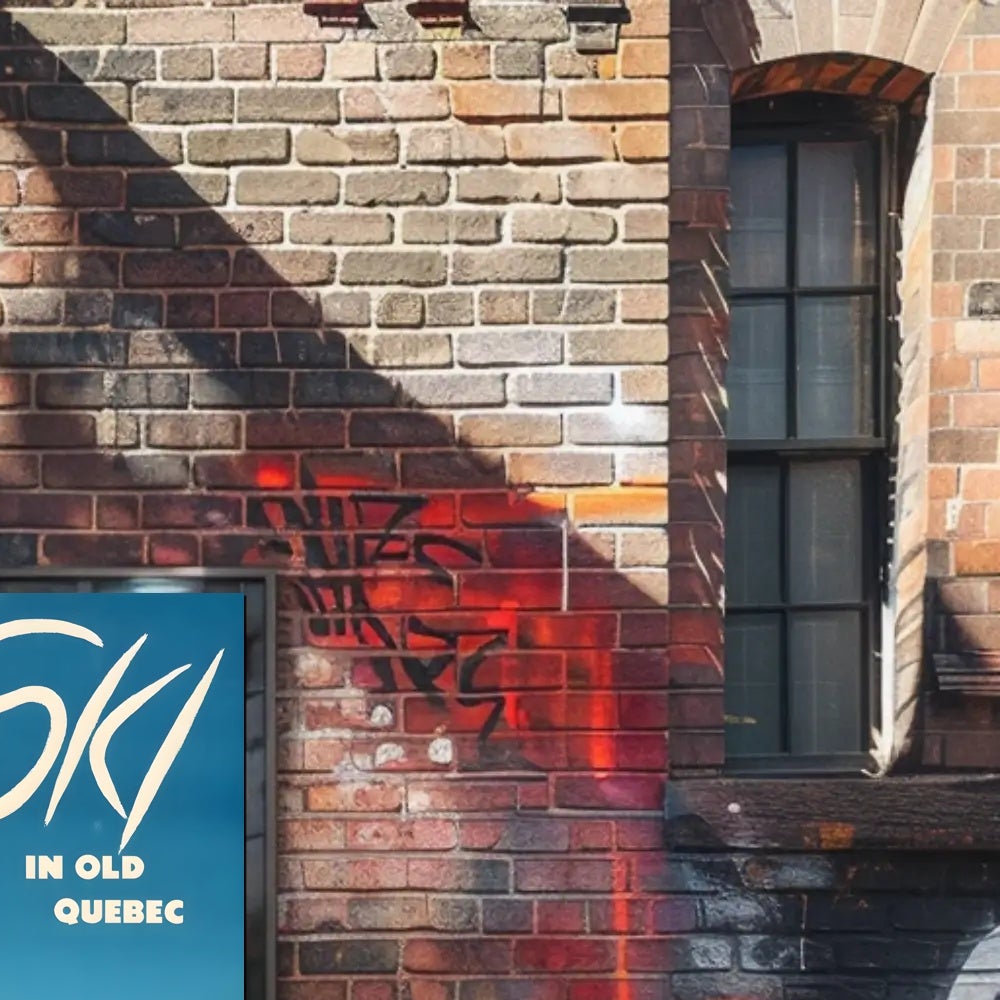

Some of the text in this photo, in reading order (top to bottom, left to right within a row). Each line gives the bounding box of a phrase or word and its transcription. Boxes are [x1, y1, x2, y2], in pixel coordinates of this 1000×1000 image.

[25, 854, 145, 880] IN OLD
[53, 897, 184, 926] QUEBEC
